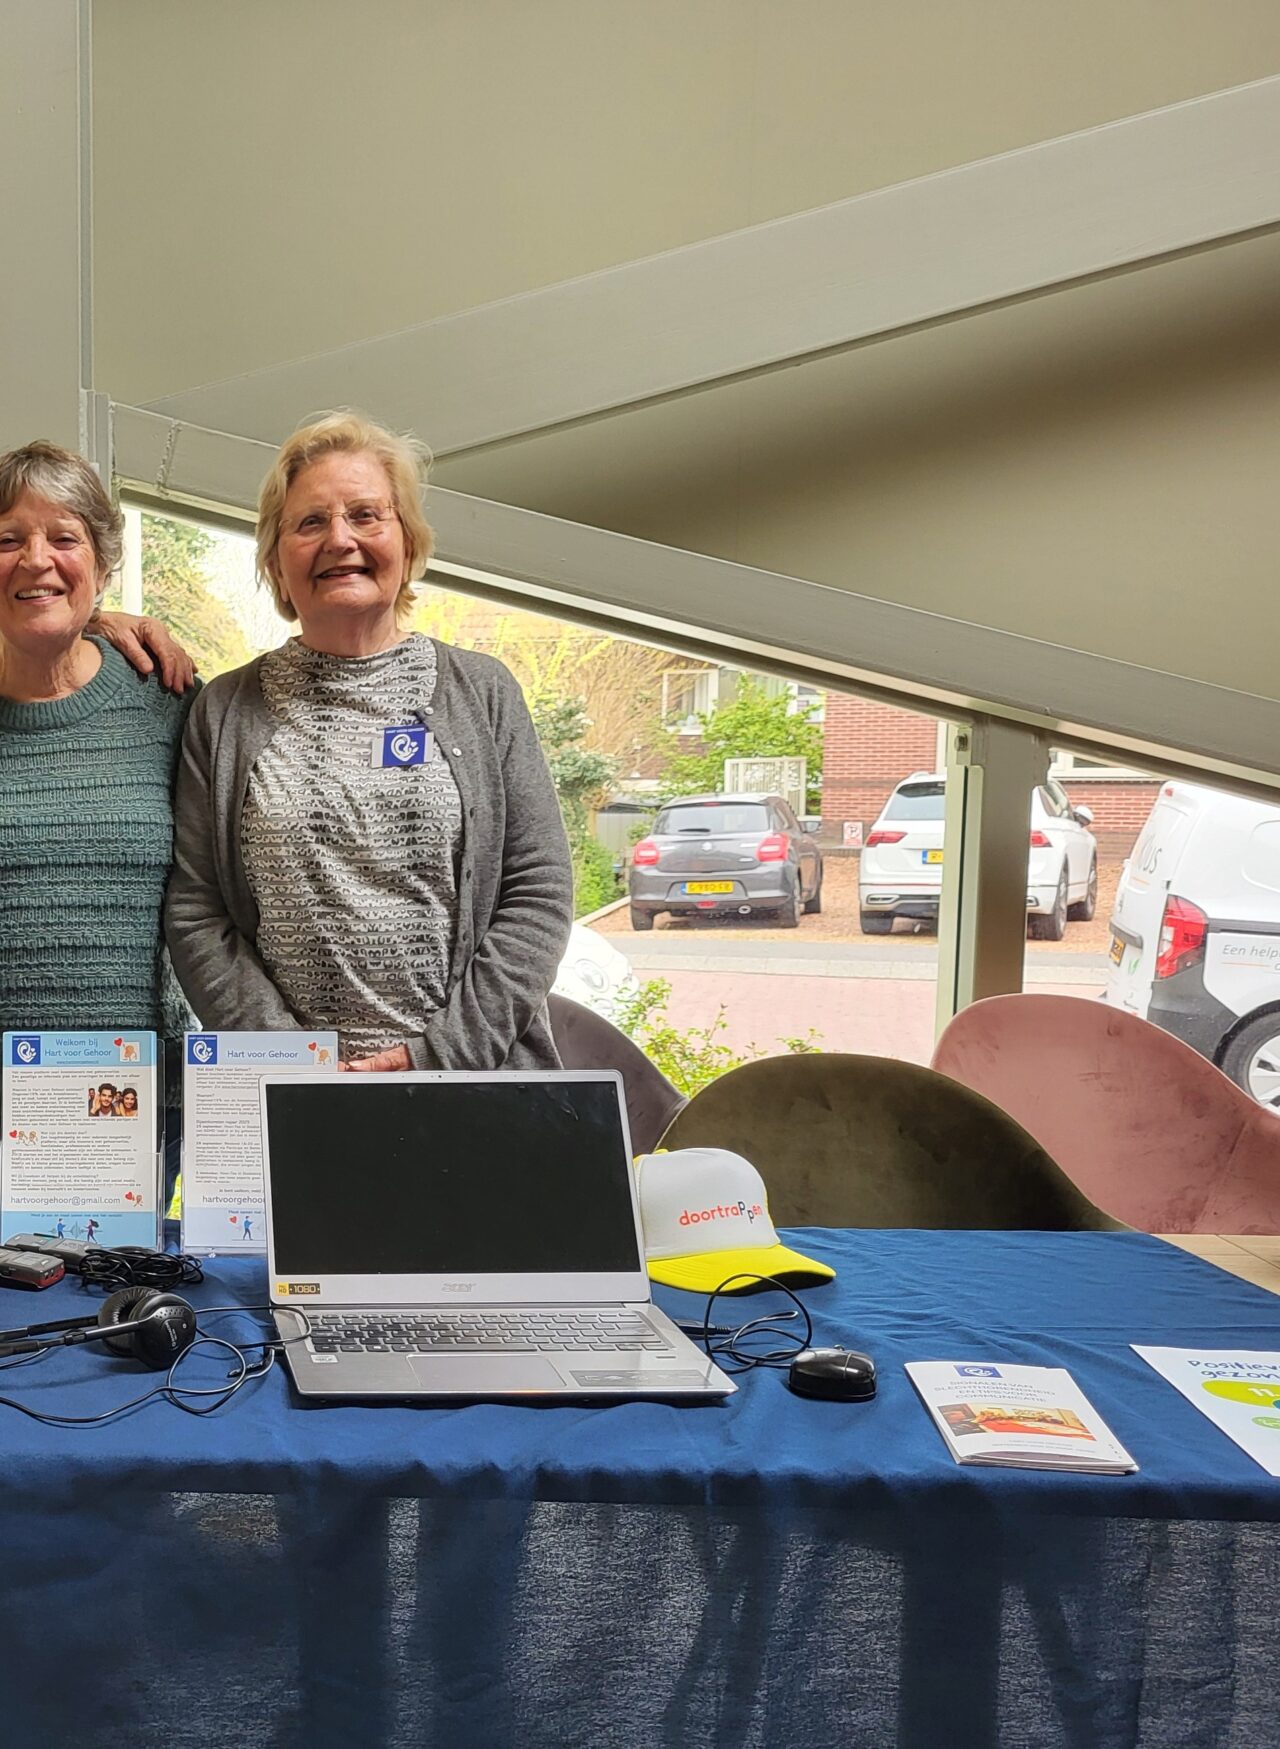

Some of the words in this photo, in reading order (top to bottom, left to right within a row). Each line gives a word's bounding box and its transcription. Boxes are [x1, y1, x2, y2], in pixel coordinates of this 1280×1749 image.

[1222, 944, 1247, 956] Een
[1250, 946, 1280, 960] help
[88, 1038, 98, 1046] bij
[10, 1196, 120, 1206] hartvoorgehoor@gmail.com
[294, 1285, 317, 1293] 1080
[441, 1283, 477, 1292] acer
[1188, 1360, 1280, 1370] Positiev
